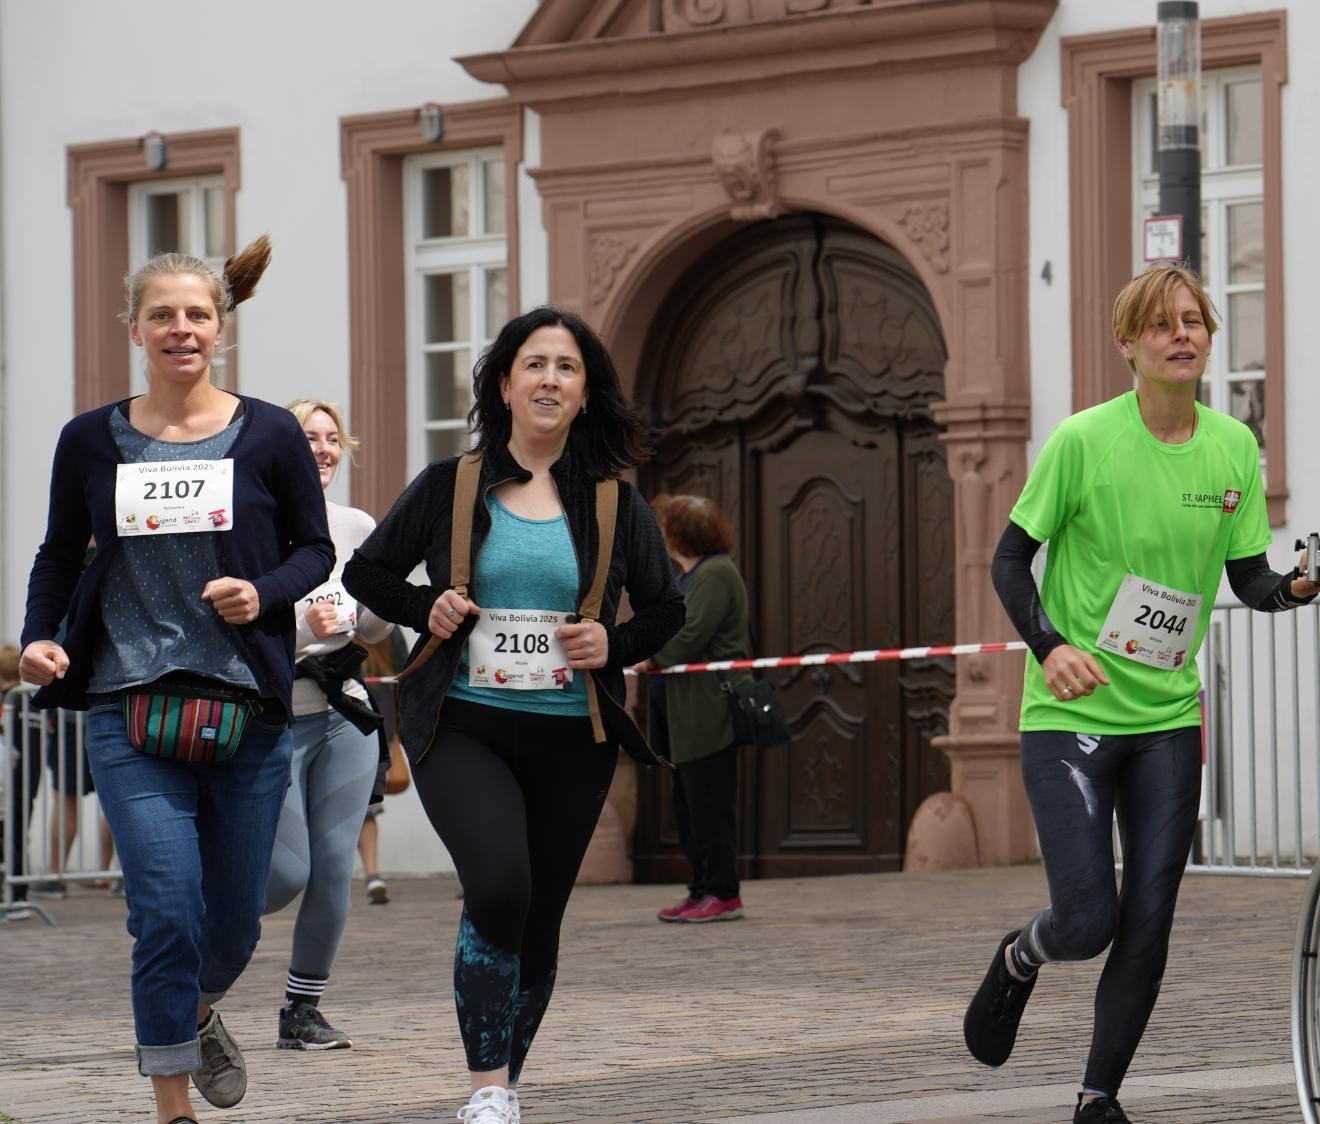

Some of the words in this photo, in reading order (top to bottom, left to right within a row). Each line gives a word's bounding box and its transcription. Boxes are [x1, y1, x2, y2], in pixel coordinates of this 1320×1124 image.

[1041, 260, 1053, 286] 4
[139, 466, 158, 474] Viva
[193, 463, 214, 471] 2025
[143, 479, 205, 500] 2107
[1142, 583, 1160, 597] Viva
[1160, 591, 1186, 605] Bolivia
[489, 613, 507, 621] Viva
[509, 614, 538, 623] Bolivia
[539, 615, 559, 624] 2025
[1134, 604, 1187, 636] 2044
[493, 632, 550, 654] 2108
